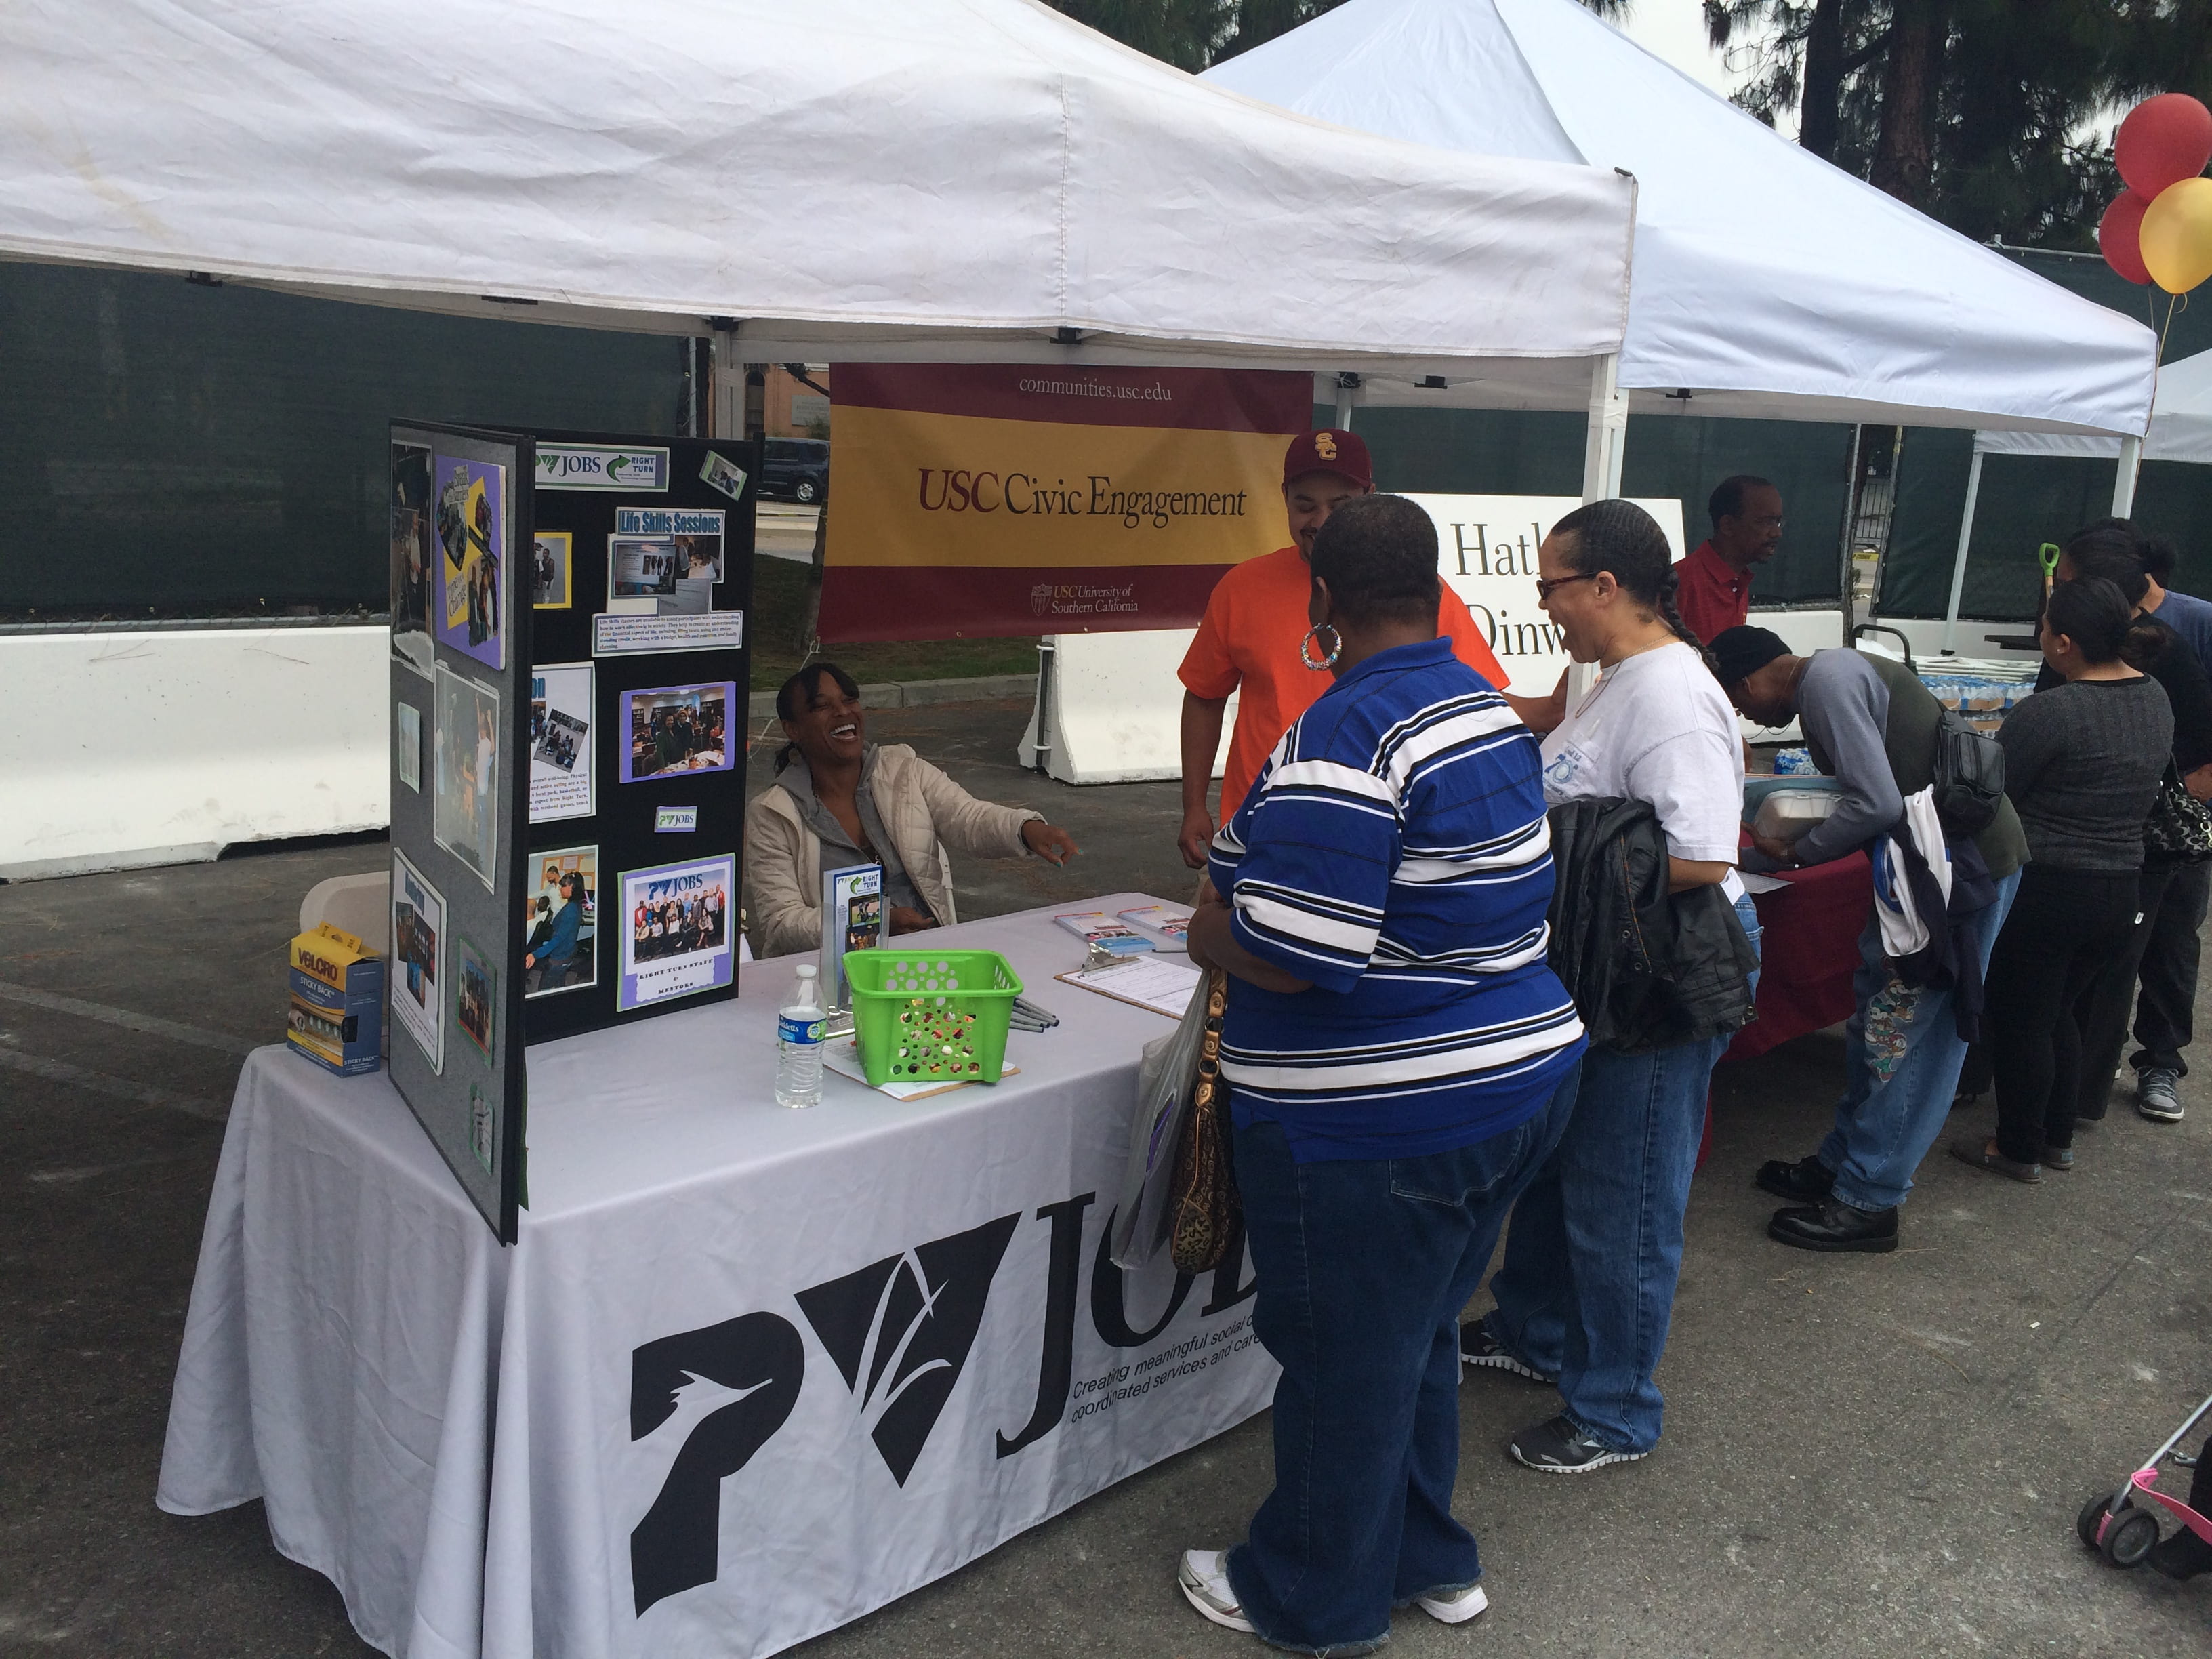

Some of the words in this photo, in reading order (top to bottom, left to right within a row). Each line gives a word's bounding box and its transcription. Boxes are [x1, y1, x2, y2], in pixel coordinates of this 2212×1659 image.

[1019, 377, 1172, 401] communities.usc.edu
[559, 455, 602, 477] JOBS
[631, 457, 655, 465] RIGHT
[632, 465, 654, 473] TURN
[918, 468, 1000, 513] USC
[1004, 473, 1082, 515] Civic
[1087, 476, 1247, 529] Engagement
[621, 511, 640, 533] Life
[642, 512, 672, 533] Skills
[674, 512, 720, 533] Sessions
[1054, 585, 1078, 598] USC
[1078, 585, 1123, 599] University
[1122, 583, 1134, 596] of
[1051, 600, 1093, 614] Southern
[1095, 599, 1139, 613] California
[673, 814, 694, 827] JOBS
[671, 873, 703, 897] JOBS
[863, 874, 879, 882] RIGHT
[863, 880, 878, 888] TURN
[639, 969, 665, 980] RIGHT
[667, 964, 687, 973] TURN
[689, 958, 714, 968] STAFF
[300, 976, 318, 992] STICKY
[658, 982, 693, 994] MENTORS
[1073, 1364, 1130, 1399] Creating
[1134, 1332, 1208, 1376] meaningful
[1210, 1315, 1246, 1345] social
[1071, 1376, 1151, 1424] coordinated
[1153, 1356, 1207, 1389] services
[1210, 1343, 1232, 1366] and
